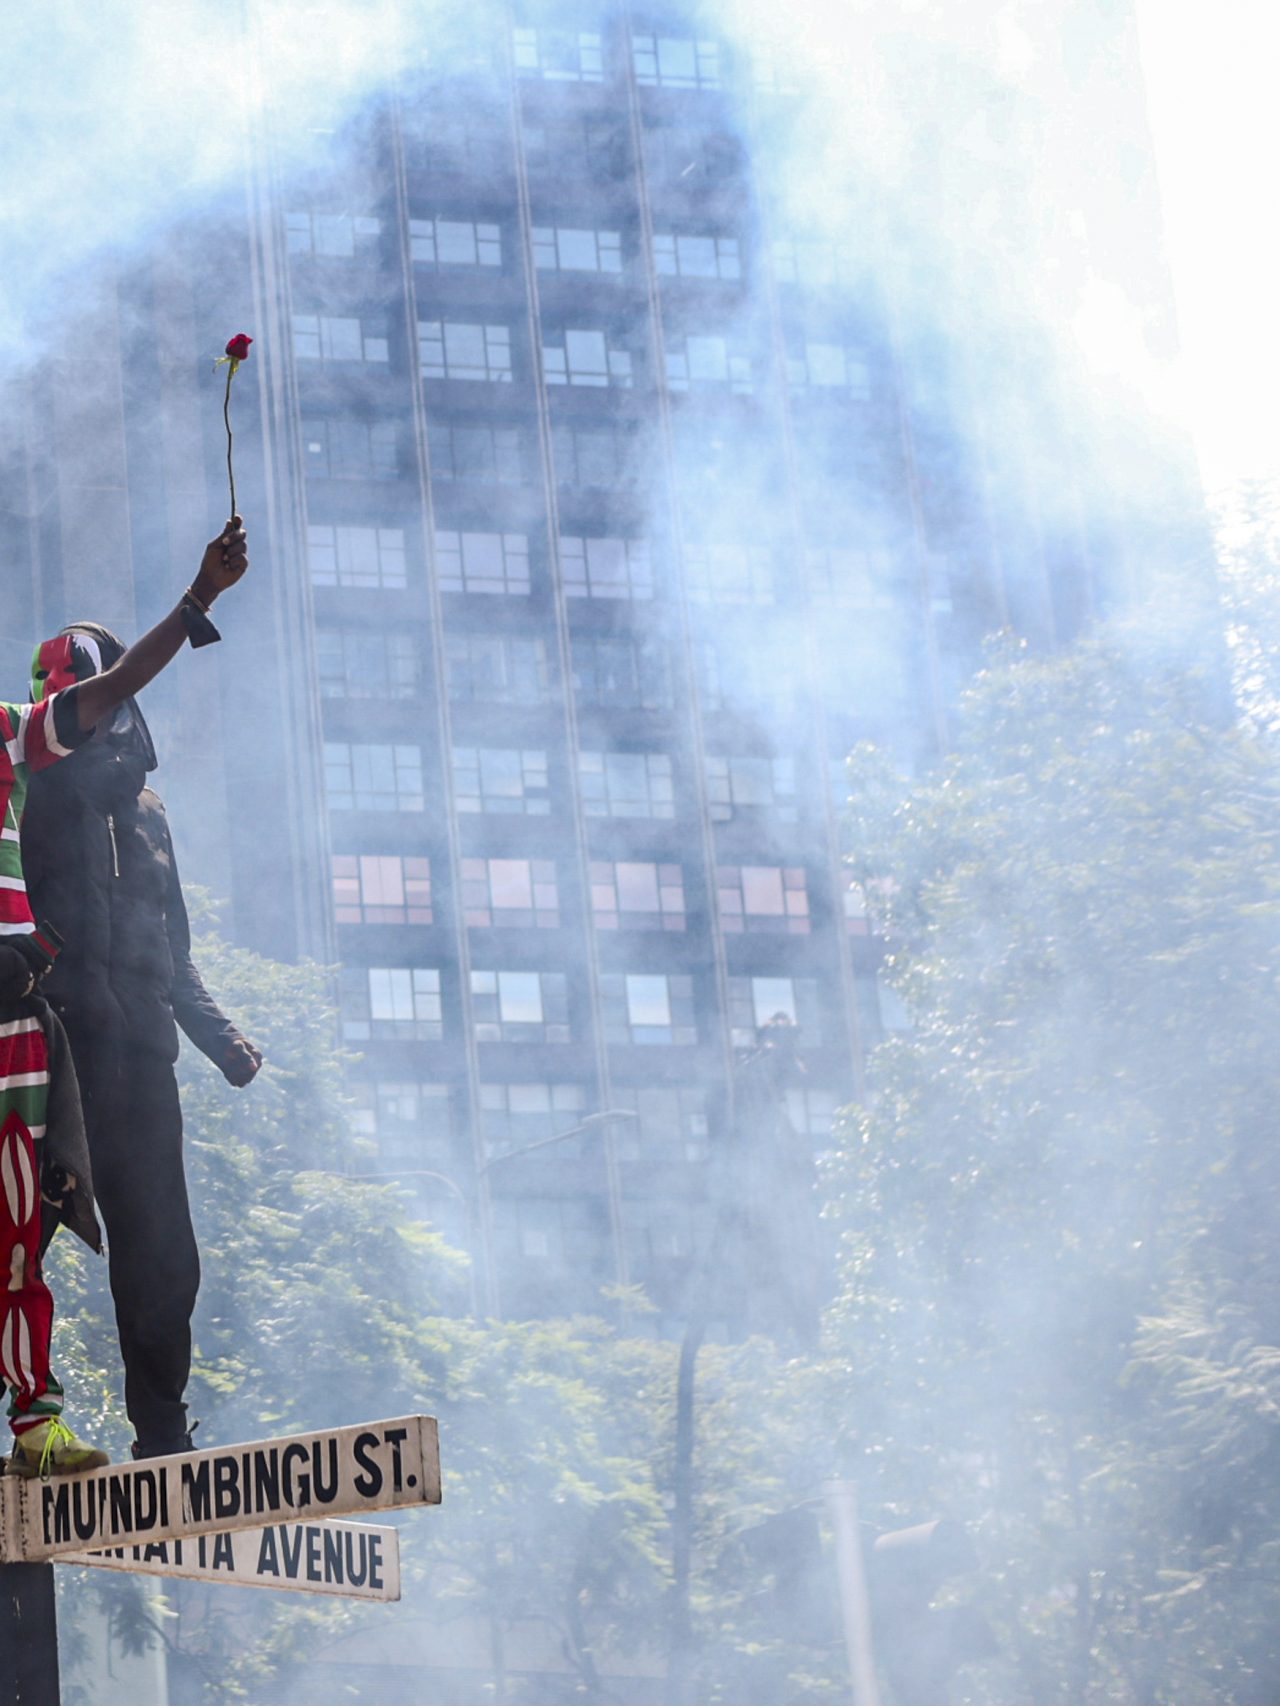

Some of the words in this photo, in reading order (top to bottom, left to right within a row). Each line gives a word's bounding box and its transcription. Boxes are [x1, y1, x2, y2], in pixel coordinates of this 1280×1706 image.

[42, 1467, 169, 1544] MUINDI
[181, 1438, 338, 1524] MBINGU
[353, 1428, 417, 1498] ST.
[256, 1524, 384, 1589] AVENUE
